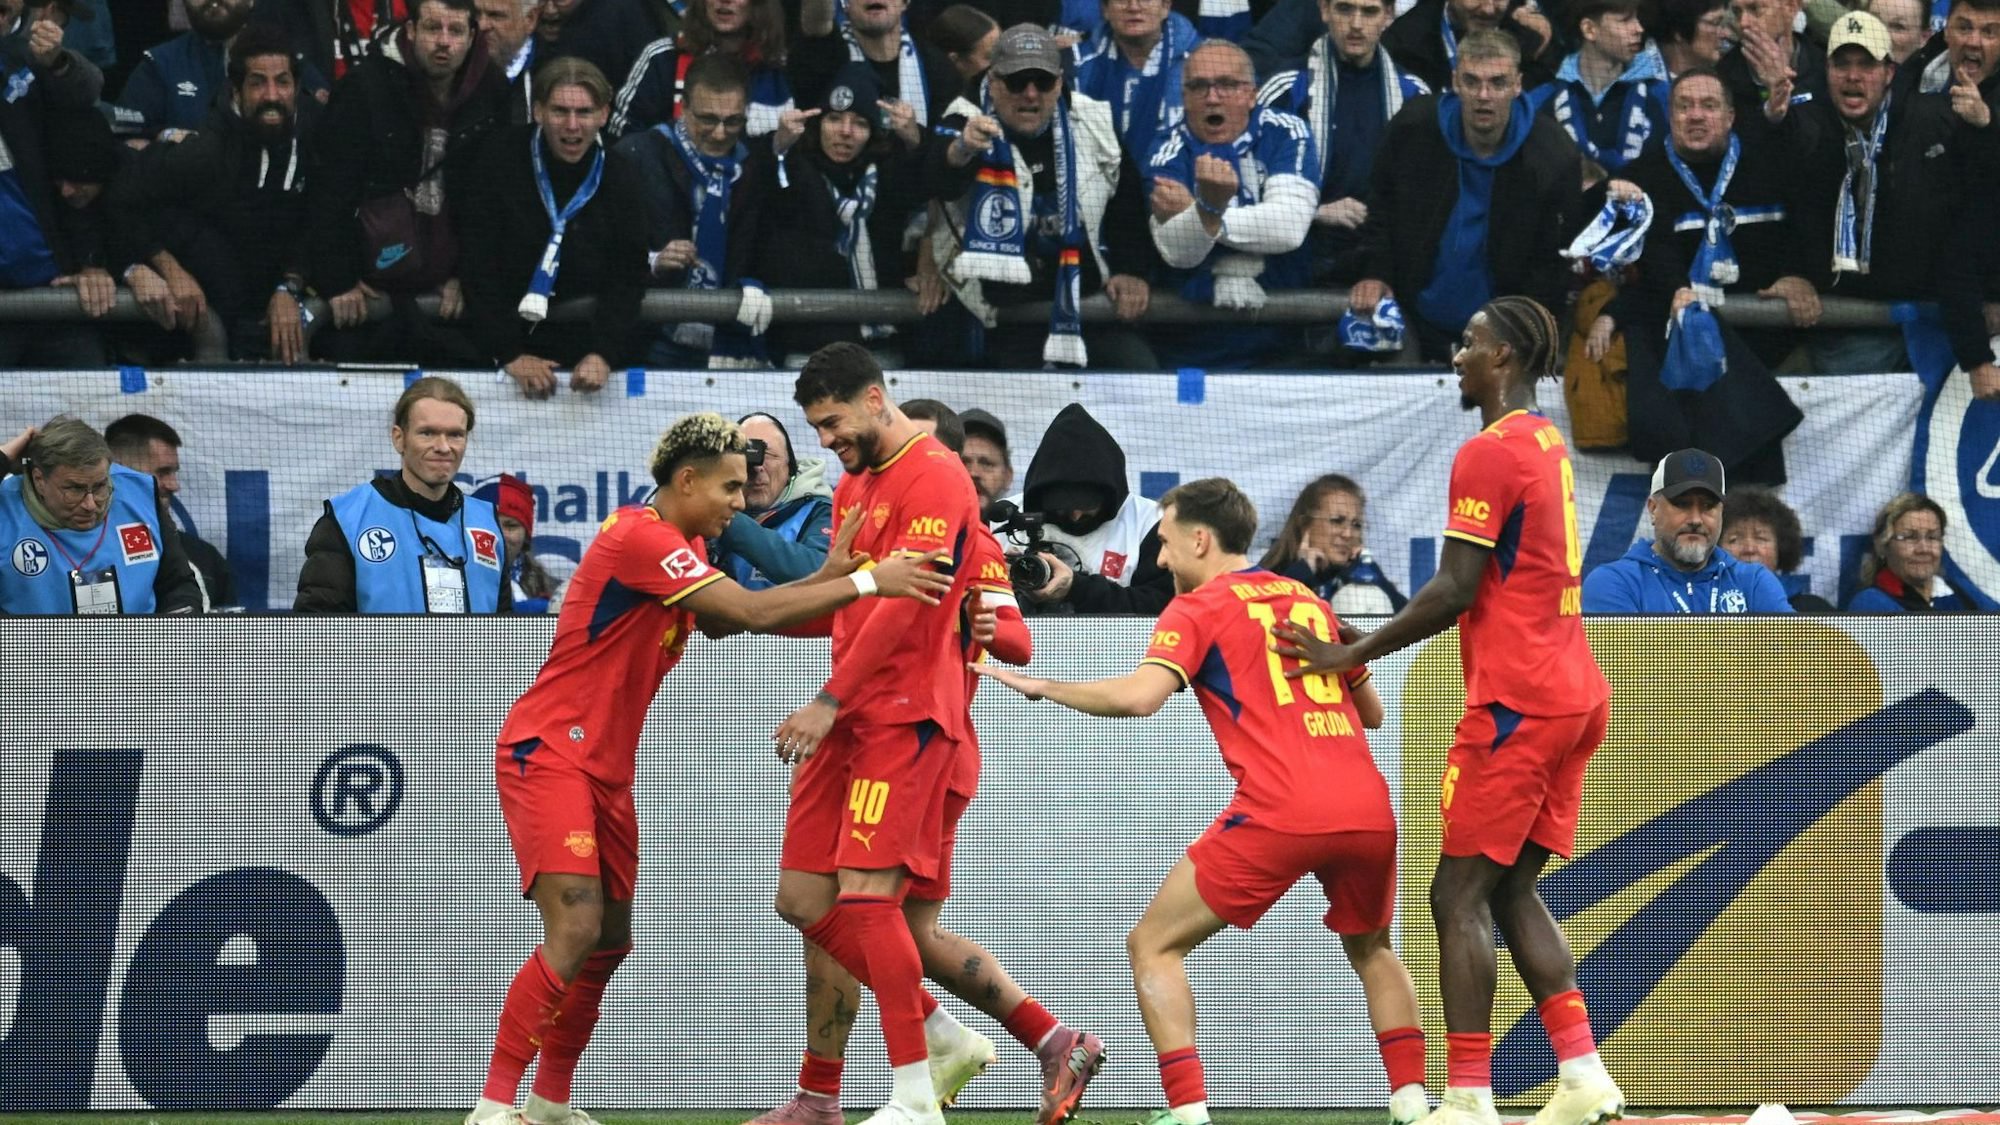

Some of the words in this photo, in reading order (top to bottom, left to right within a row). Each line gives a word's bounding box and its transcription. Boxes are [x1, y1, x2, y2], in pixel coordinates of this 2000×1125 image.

[1848, 17, 1863, 34] LA
[1256, 576, 1319, 601] LEIPZI
[1303, 710, 1356, 738] GRUDA
[848, 778, 890, 825] 40
[1442, 766, 1460, 810] 6
